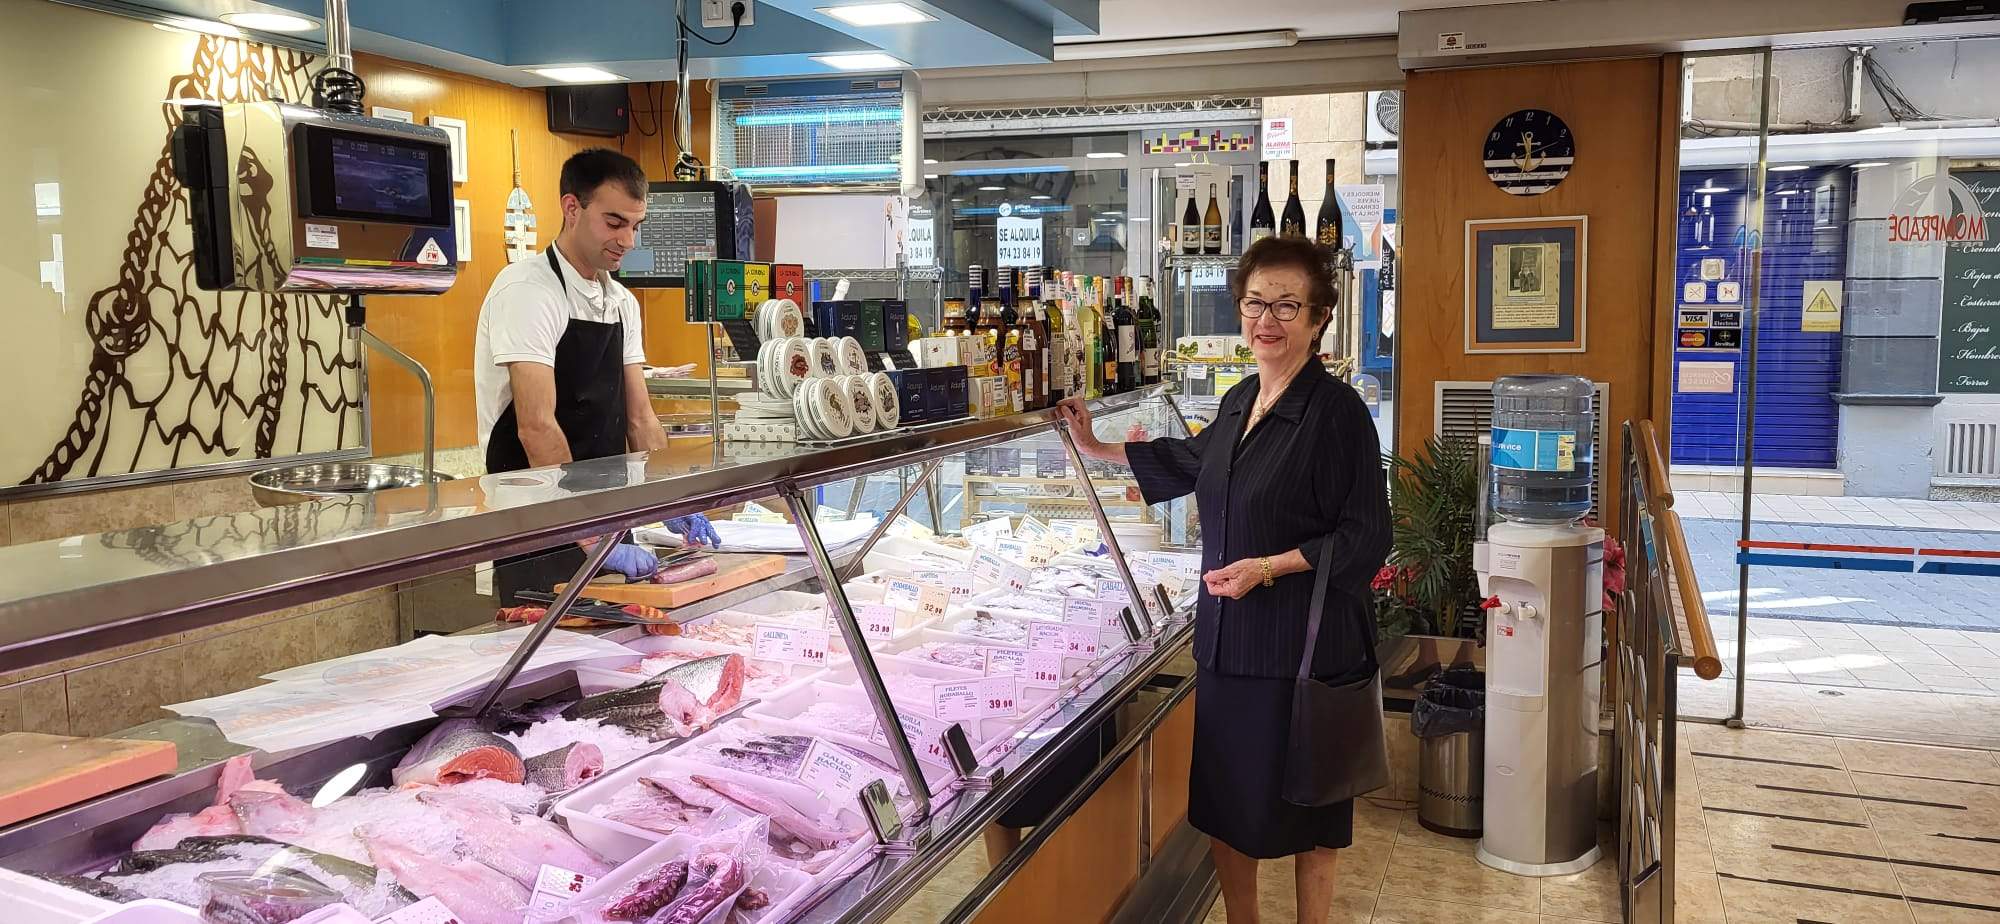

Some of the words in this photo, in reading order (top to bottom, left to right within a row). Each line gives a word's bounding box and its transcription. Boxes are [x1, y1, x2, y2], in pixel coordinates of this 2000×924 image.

[1505, 117, 1513, 127] 11
[1525, 112, 1534, 121] 12
[1491, 131, 1501, 141] 10
[1559, 128, 1567, 138] 2
[1487, 149, 1495, 159] 9
[1563, 147, 1570, 156] 3
[909, 228, 932, 241] QUILA
[999, 228, 1008, 241] SE
[1010, 228, 1040, 241] ALQUILA
[925, 247, 932, 259] 19
[999, 247, 1011, 259] 974
[1013, 247, 1021, 259] 23
[1022, 247, 1031, 259] 84
[1033, 247, 1041, 259] 19
[1958, 321, 1990, 341] Bajos
[1956, 375, 1989, 386] Forros
[892, 581, 919, 593] RODABALLO
[997, 649, 1023, 657] FILETES
[823, 751, 852, 770] GALLO
[816, 756, 852, 779] RACION
